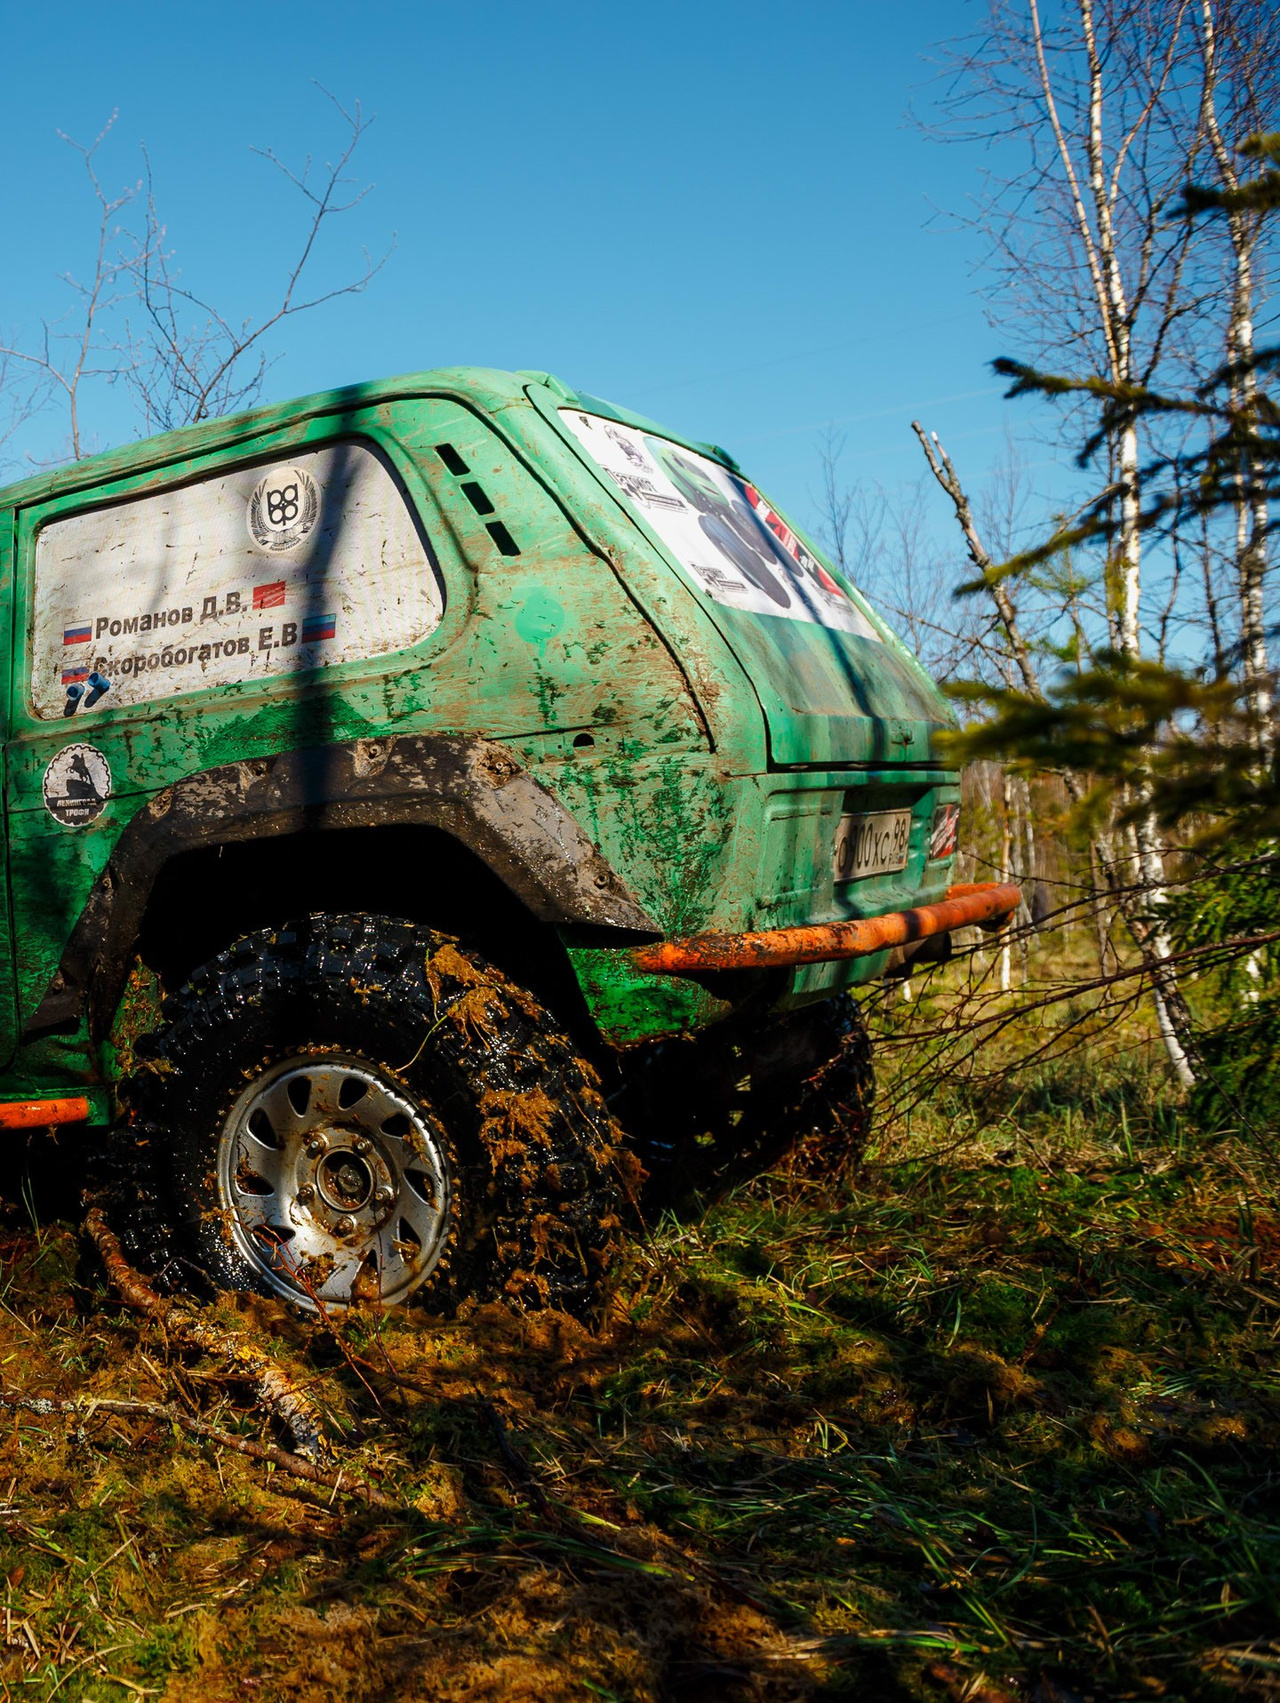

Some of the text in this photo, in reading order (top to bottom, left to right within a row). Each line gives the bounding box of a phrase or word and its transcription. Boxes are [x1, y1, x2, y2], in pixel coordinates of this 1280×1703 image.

[95, 591, 249, 640] Романов Д.В.
[93, 621, 298, 678] Скоробогатов Е.В
